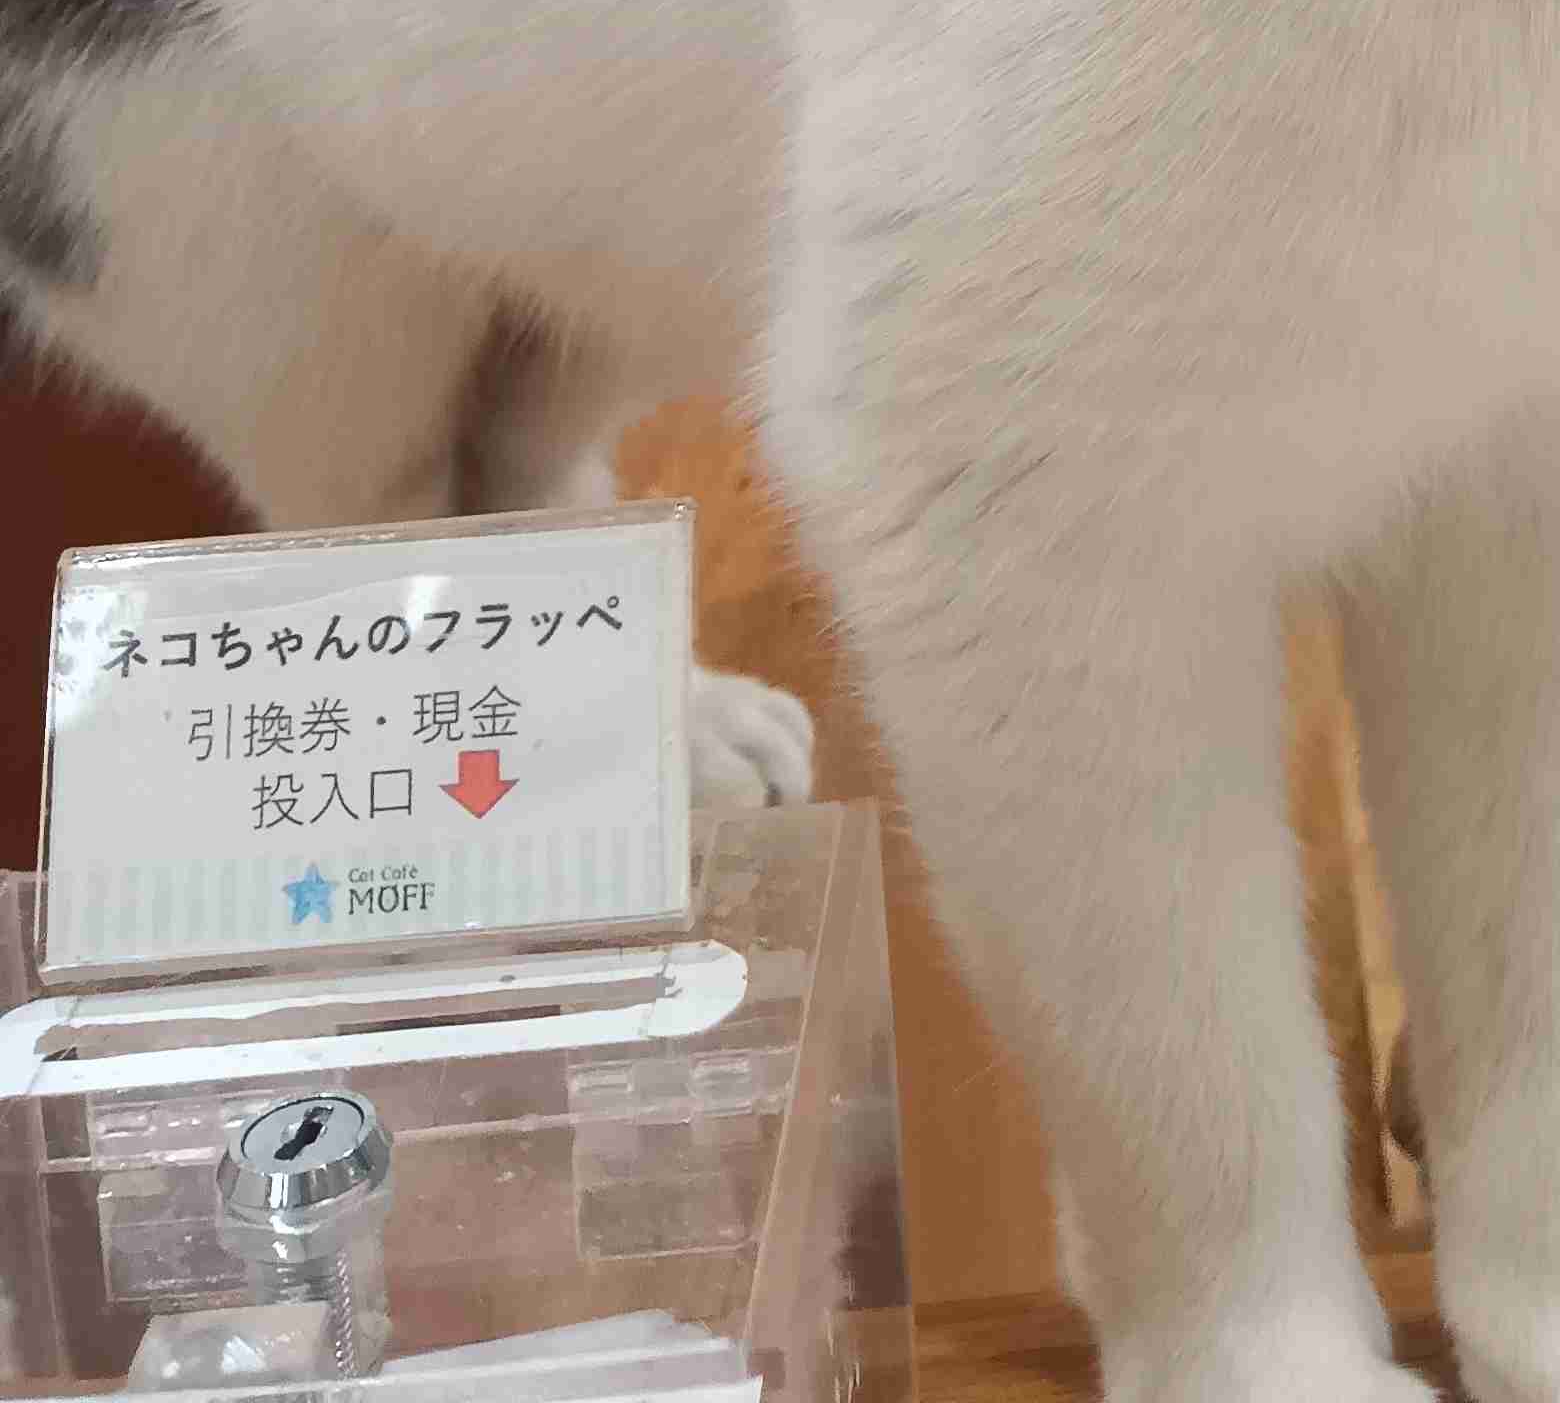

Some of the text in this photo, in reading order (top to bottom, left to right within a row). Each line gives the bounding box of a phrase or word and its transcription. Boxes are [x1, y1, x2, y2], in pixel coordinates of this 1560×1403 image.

[104, 595, 624, 678] ネコちゃんのフラッペ
[187, 685, 522, 761] 引換券・現金
[252, 768, 413, 830] 投入口
[348, 867, 375, 883] Cat
[348, 882, 436, 915] MOFF
